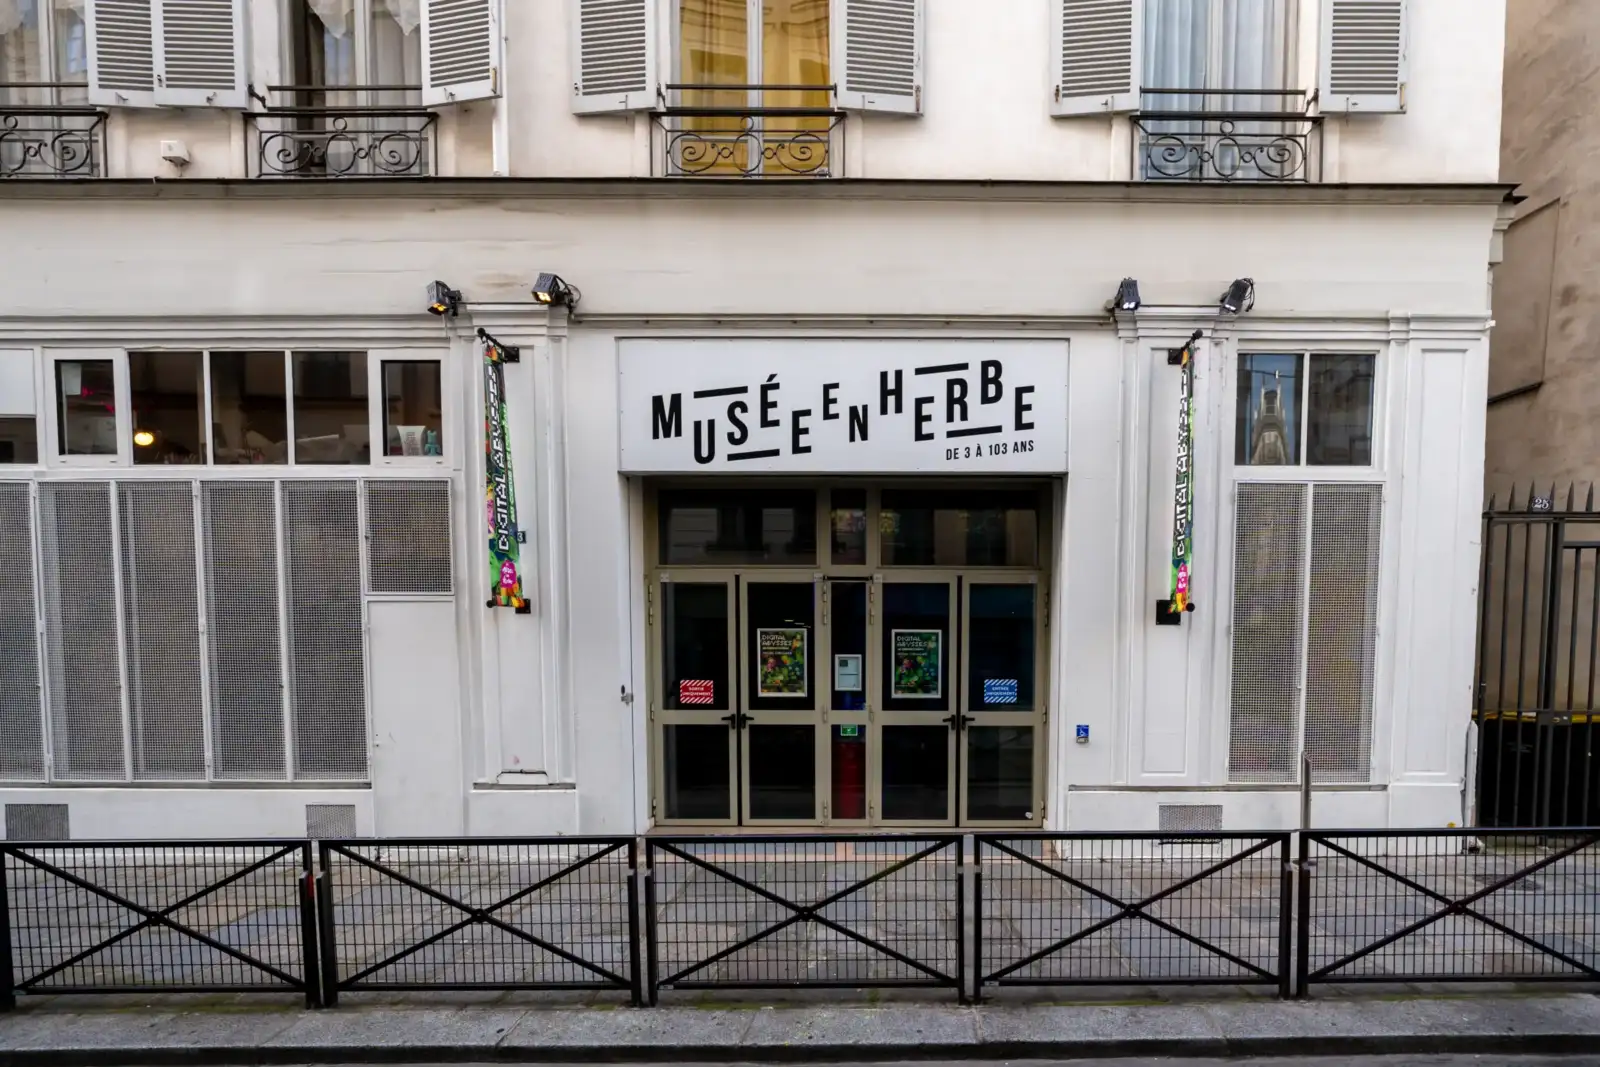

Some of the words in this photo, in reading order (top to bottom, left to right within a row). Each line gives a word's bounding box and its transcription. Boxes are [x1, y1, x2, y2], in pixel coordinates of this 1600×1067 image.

[946, 448, 959, 461] DE
[964, 447, 971, 458] 3
[976, 443, 982, 457] À
[989, 443, 1008, 456] 103
[1013, 440, 1034, 453] ANS
[495, 474, 509, 551] DIGITAL
[1176, 477, 1187, 557] DIGITAL
